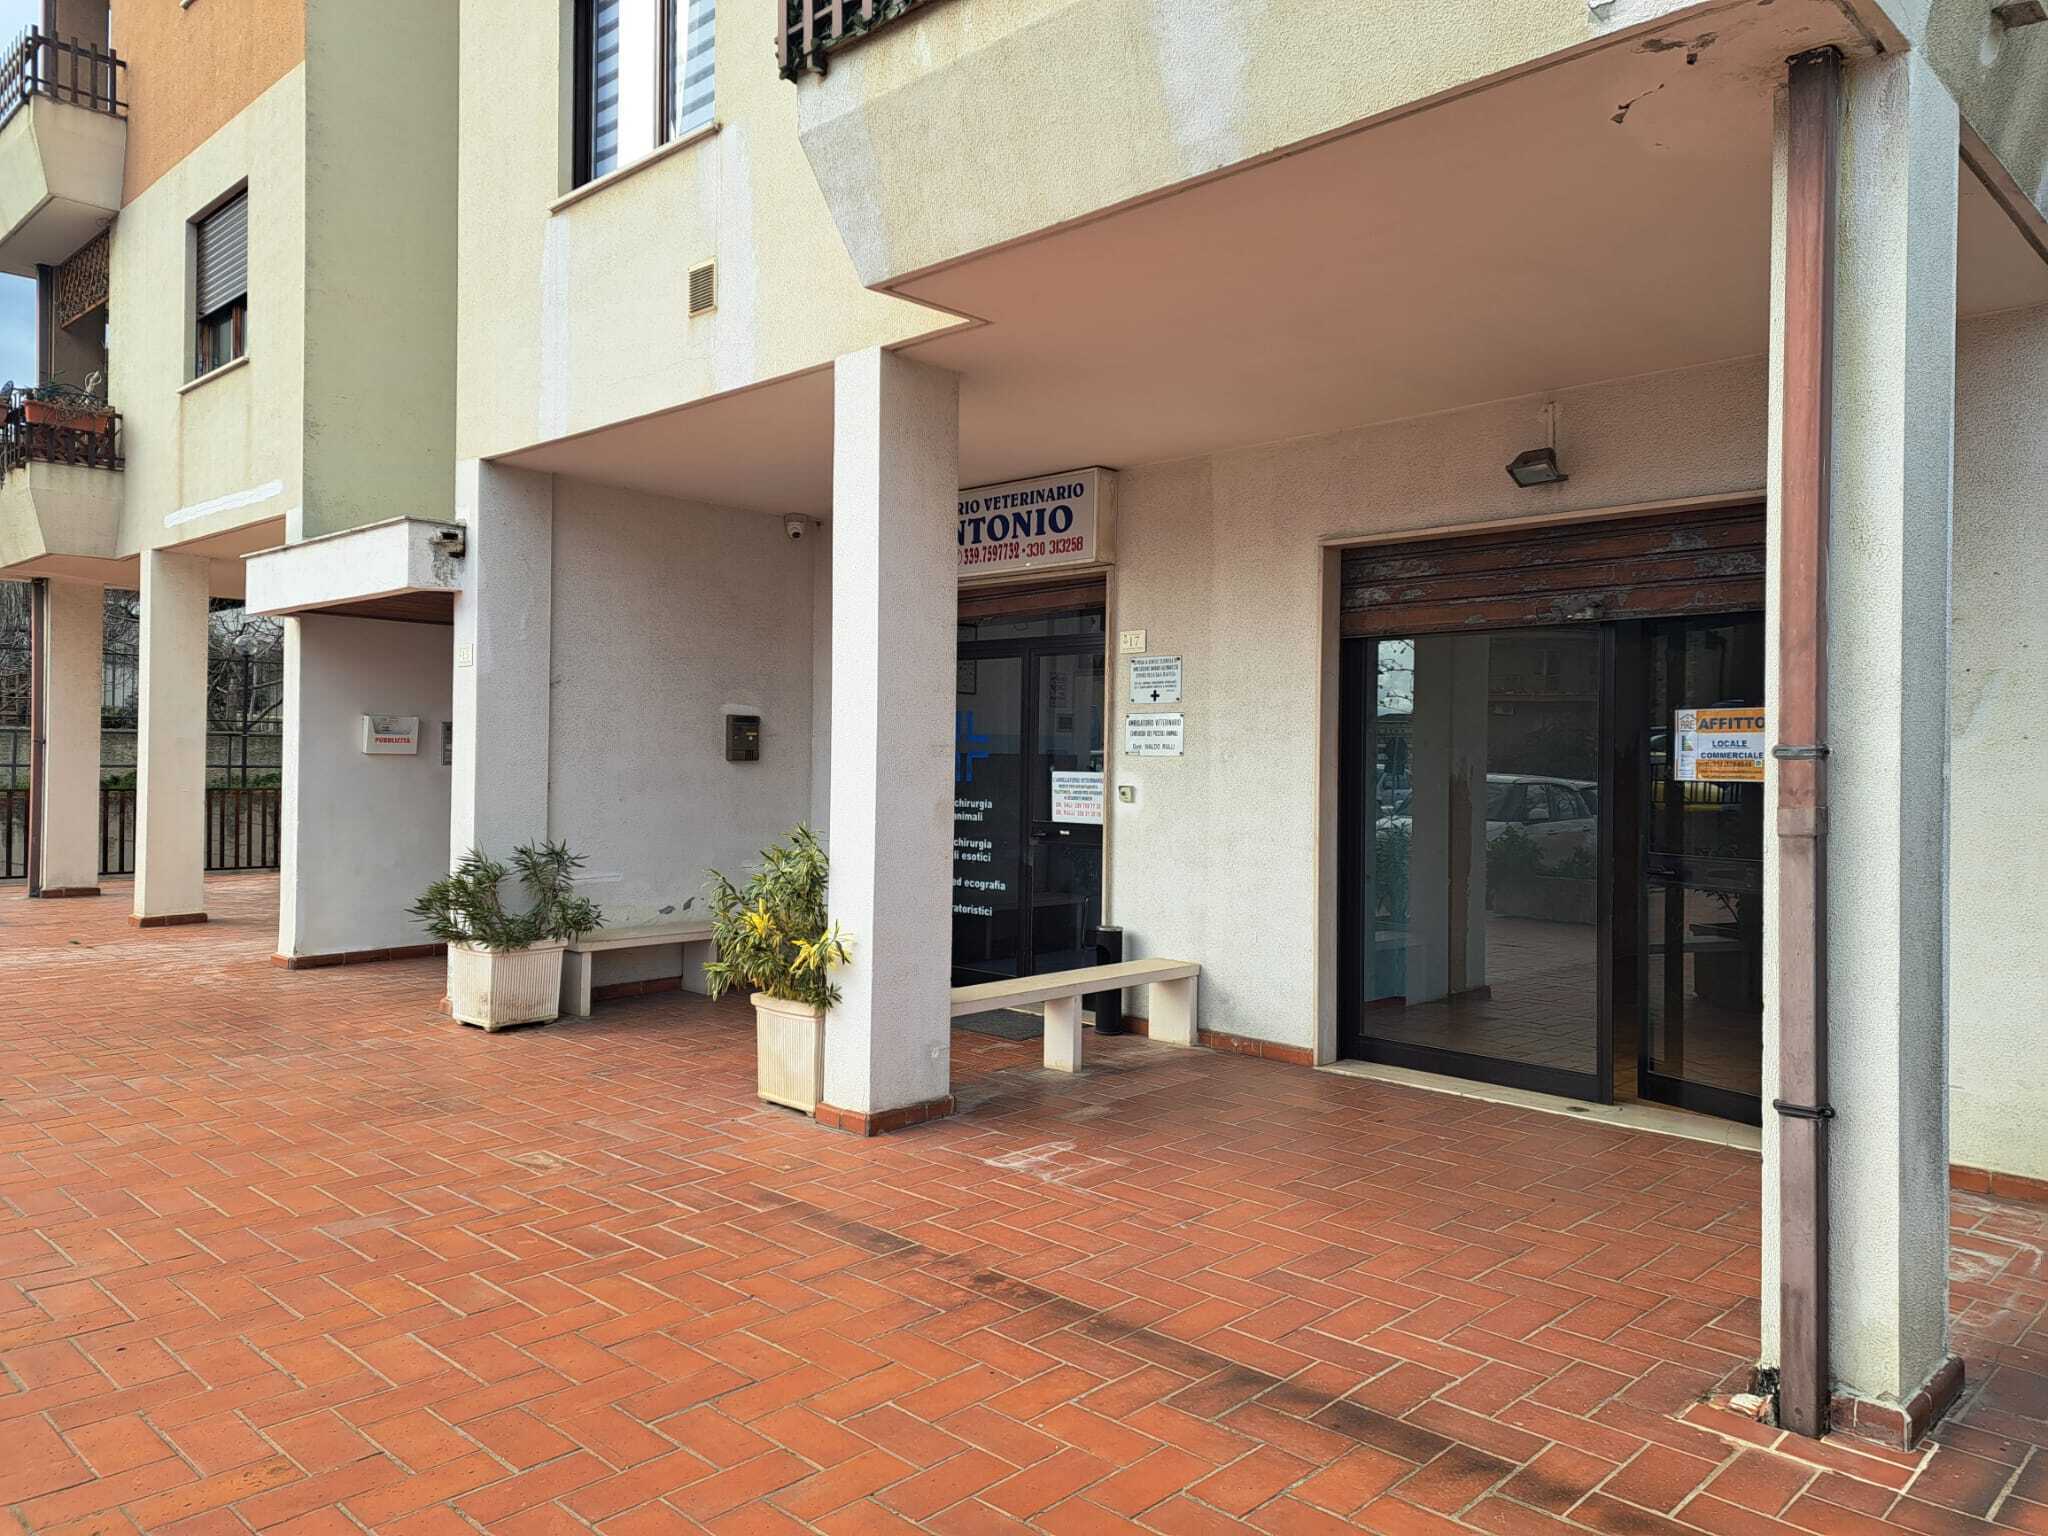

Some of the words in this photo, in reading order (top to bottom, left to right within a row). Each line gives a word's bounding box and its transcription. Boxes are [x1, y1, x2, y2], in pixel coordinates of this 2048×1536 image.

[984, 483, 1084, 511] VETERINARIO
[1049, 535, 1084, 555] 313258
[1699, 716, 1764, 729] AFFITTO
[1712, 740, 1747, 748] LOCALE
[954, 799, 992, 810] chirurgia
[953, 838, 992, 850] chirurgia
[961, 852, 991, 862] esotici
[964, 879, 1006, 890] ecografia
